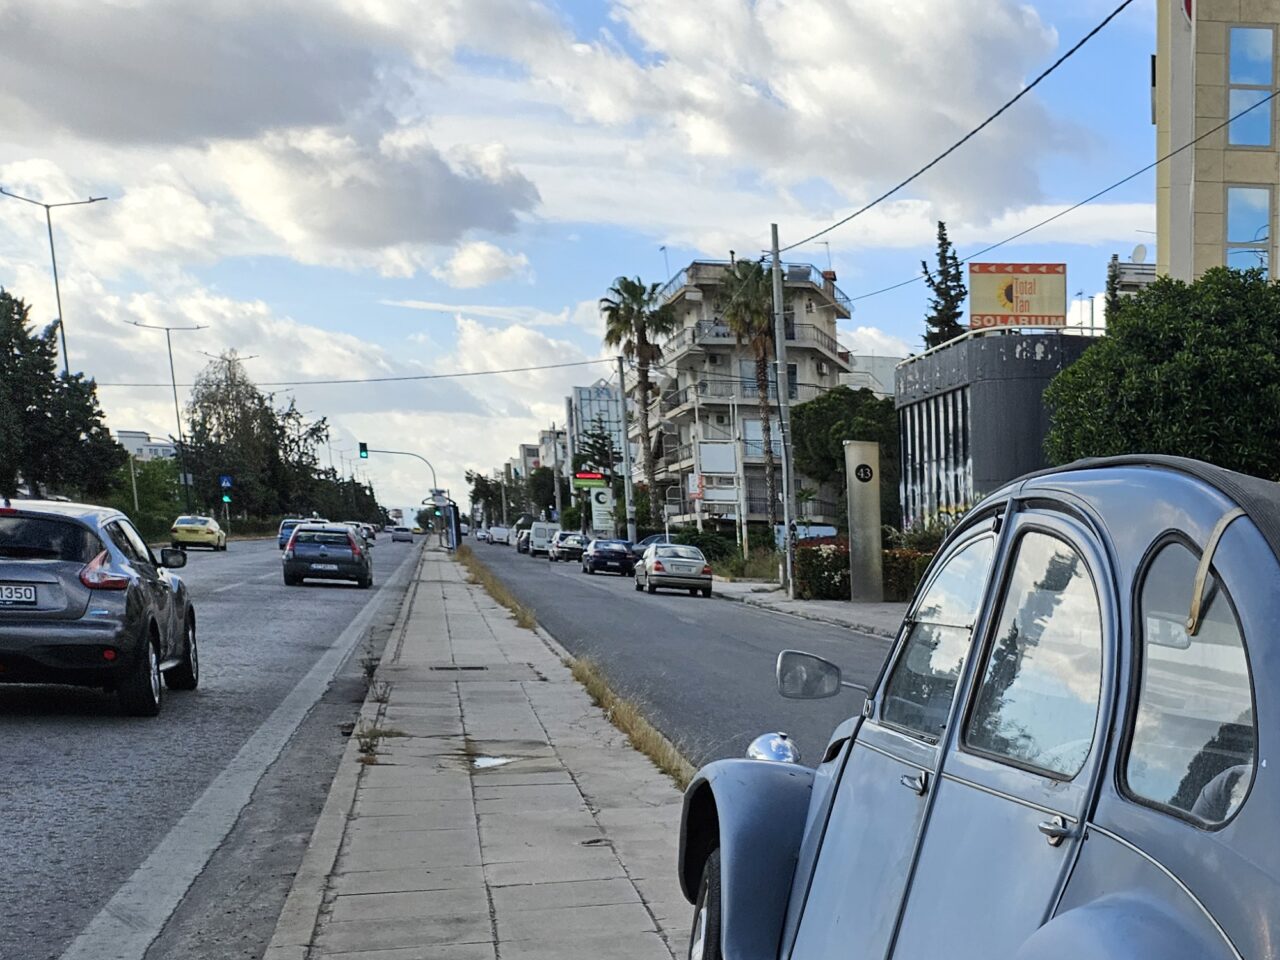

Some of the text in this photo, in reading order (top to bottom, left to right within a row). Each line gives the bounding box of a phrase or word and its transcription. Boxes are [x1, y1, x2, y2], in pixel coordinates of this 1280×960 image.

[1013, 278, 1036, 295] Total
[1013, 296, 1030, 313] Tan
[971, 315, 1064, 326] SOLARIUM
[857, 468, 871, 479] 43
